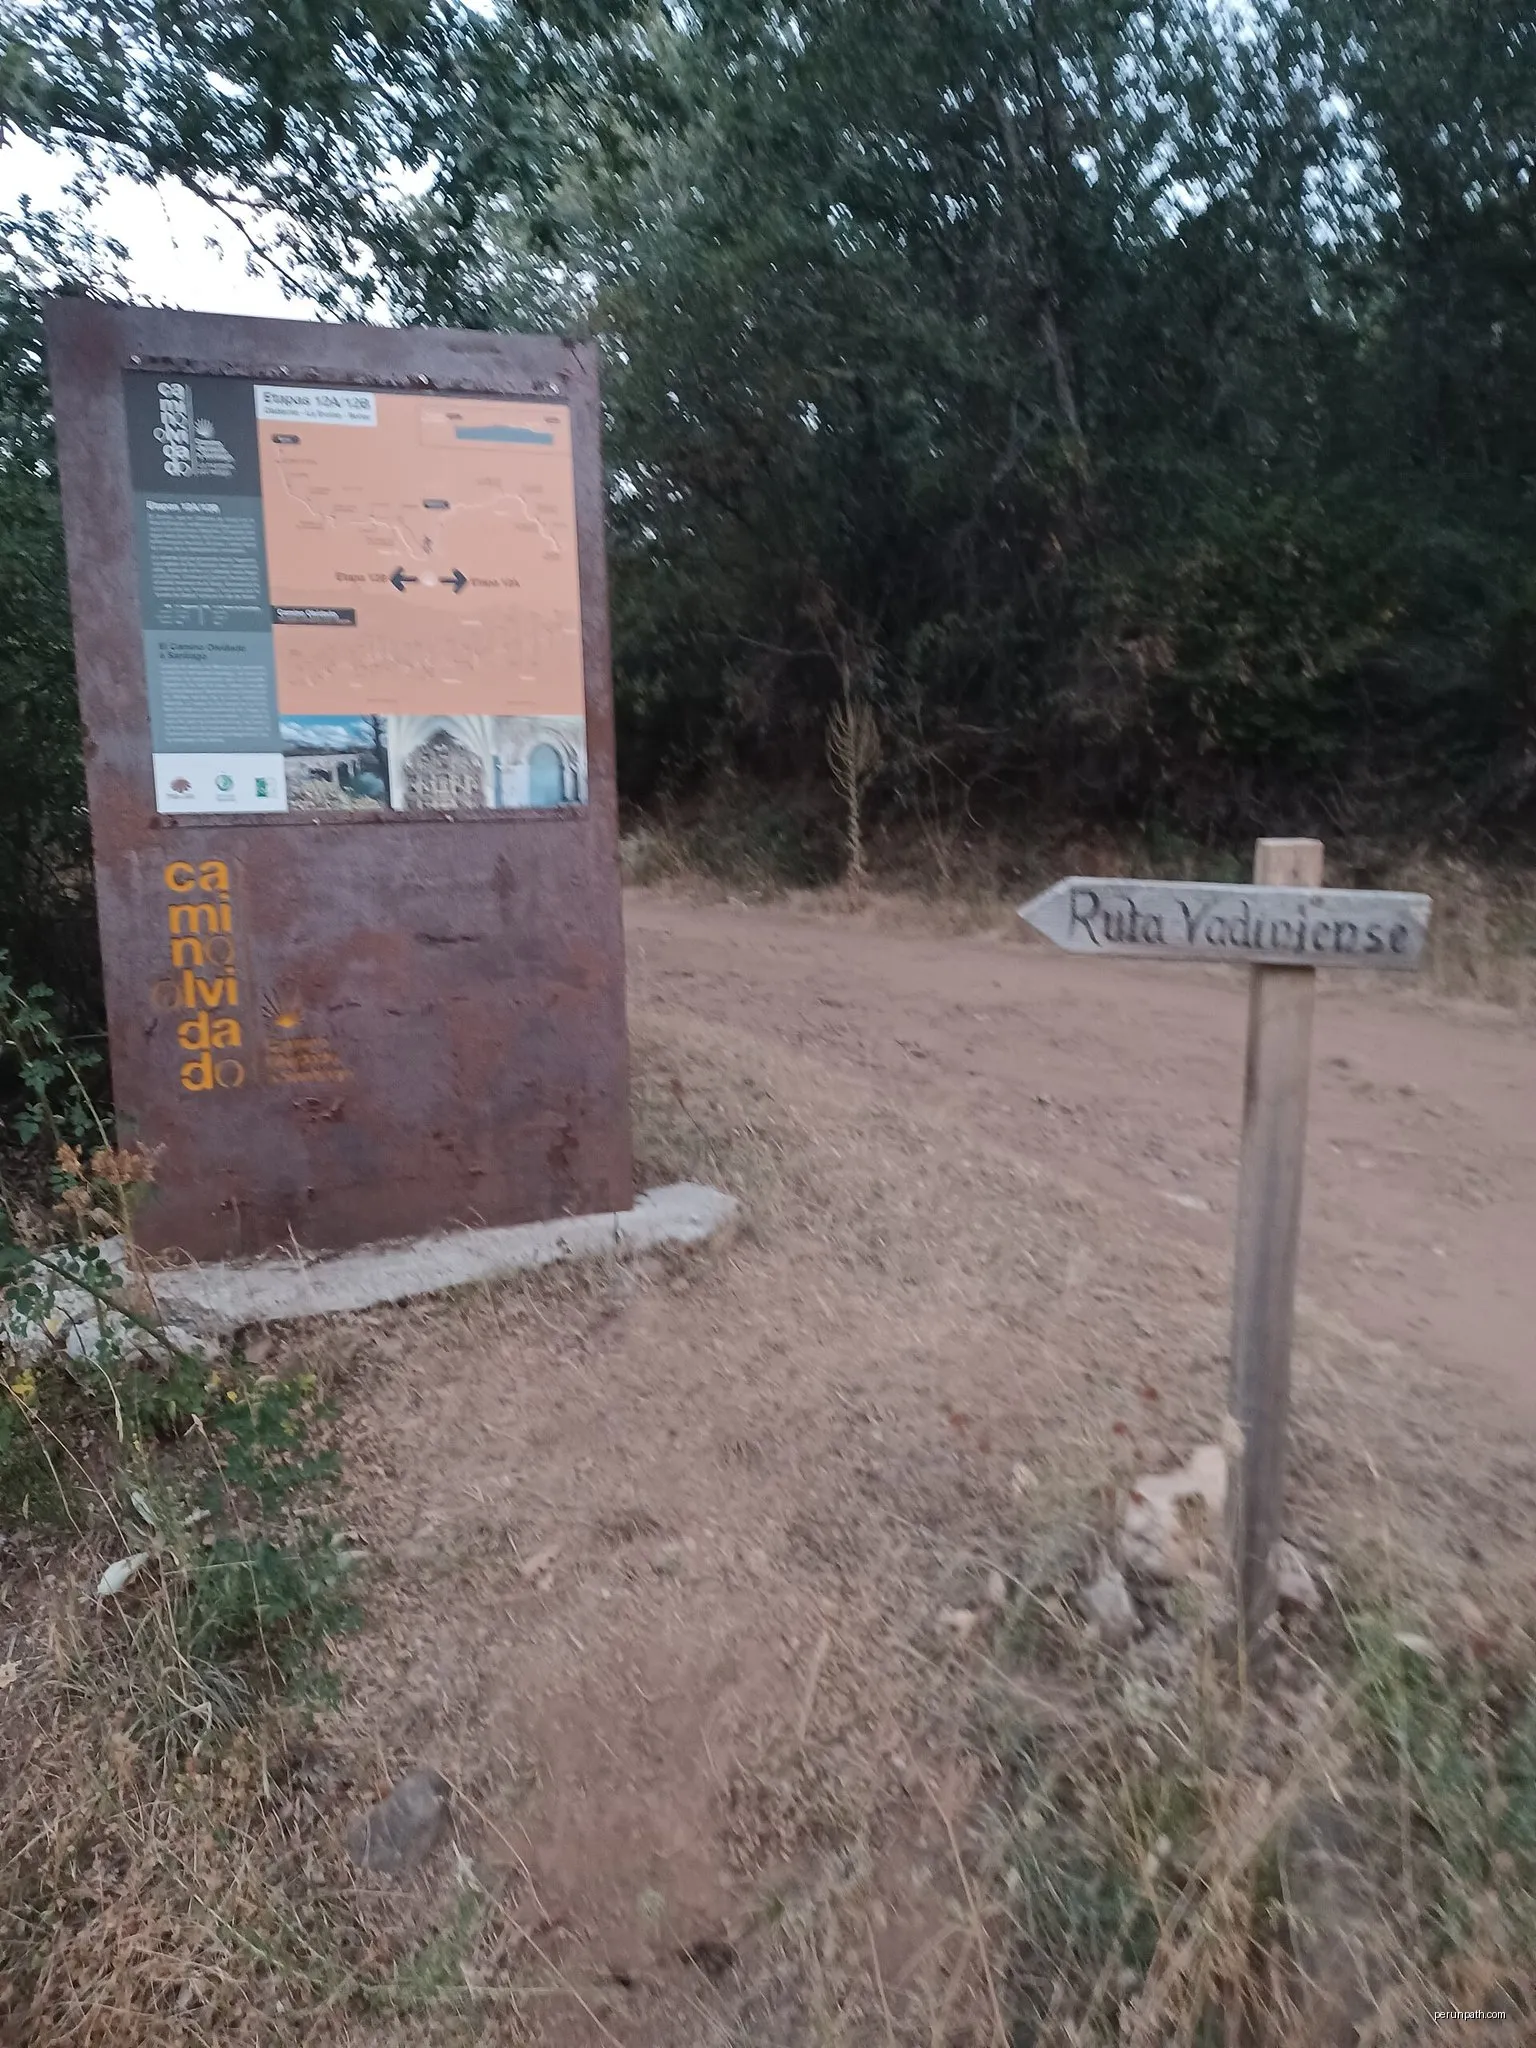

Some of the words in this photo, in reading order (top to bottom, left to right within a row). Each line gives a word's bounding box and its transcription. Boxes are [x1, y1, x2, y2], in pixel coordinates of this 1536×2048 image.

[163, 860, 230, 892] ca
[168, 891, 232, 934] mi
[1068, 887, 1166, 948] Ruta
[177, 1010, 242, 1050] da
[180, 1050, 245, 1092] do
